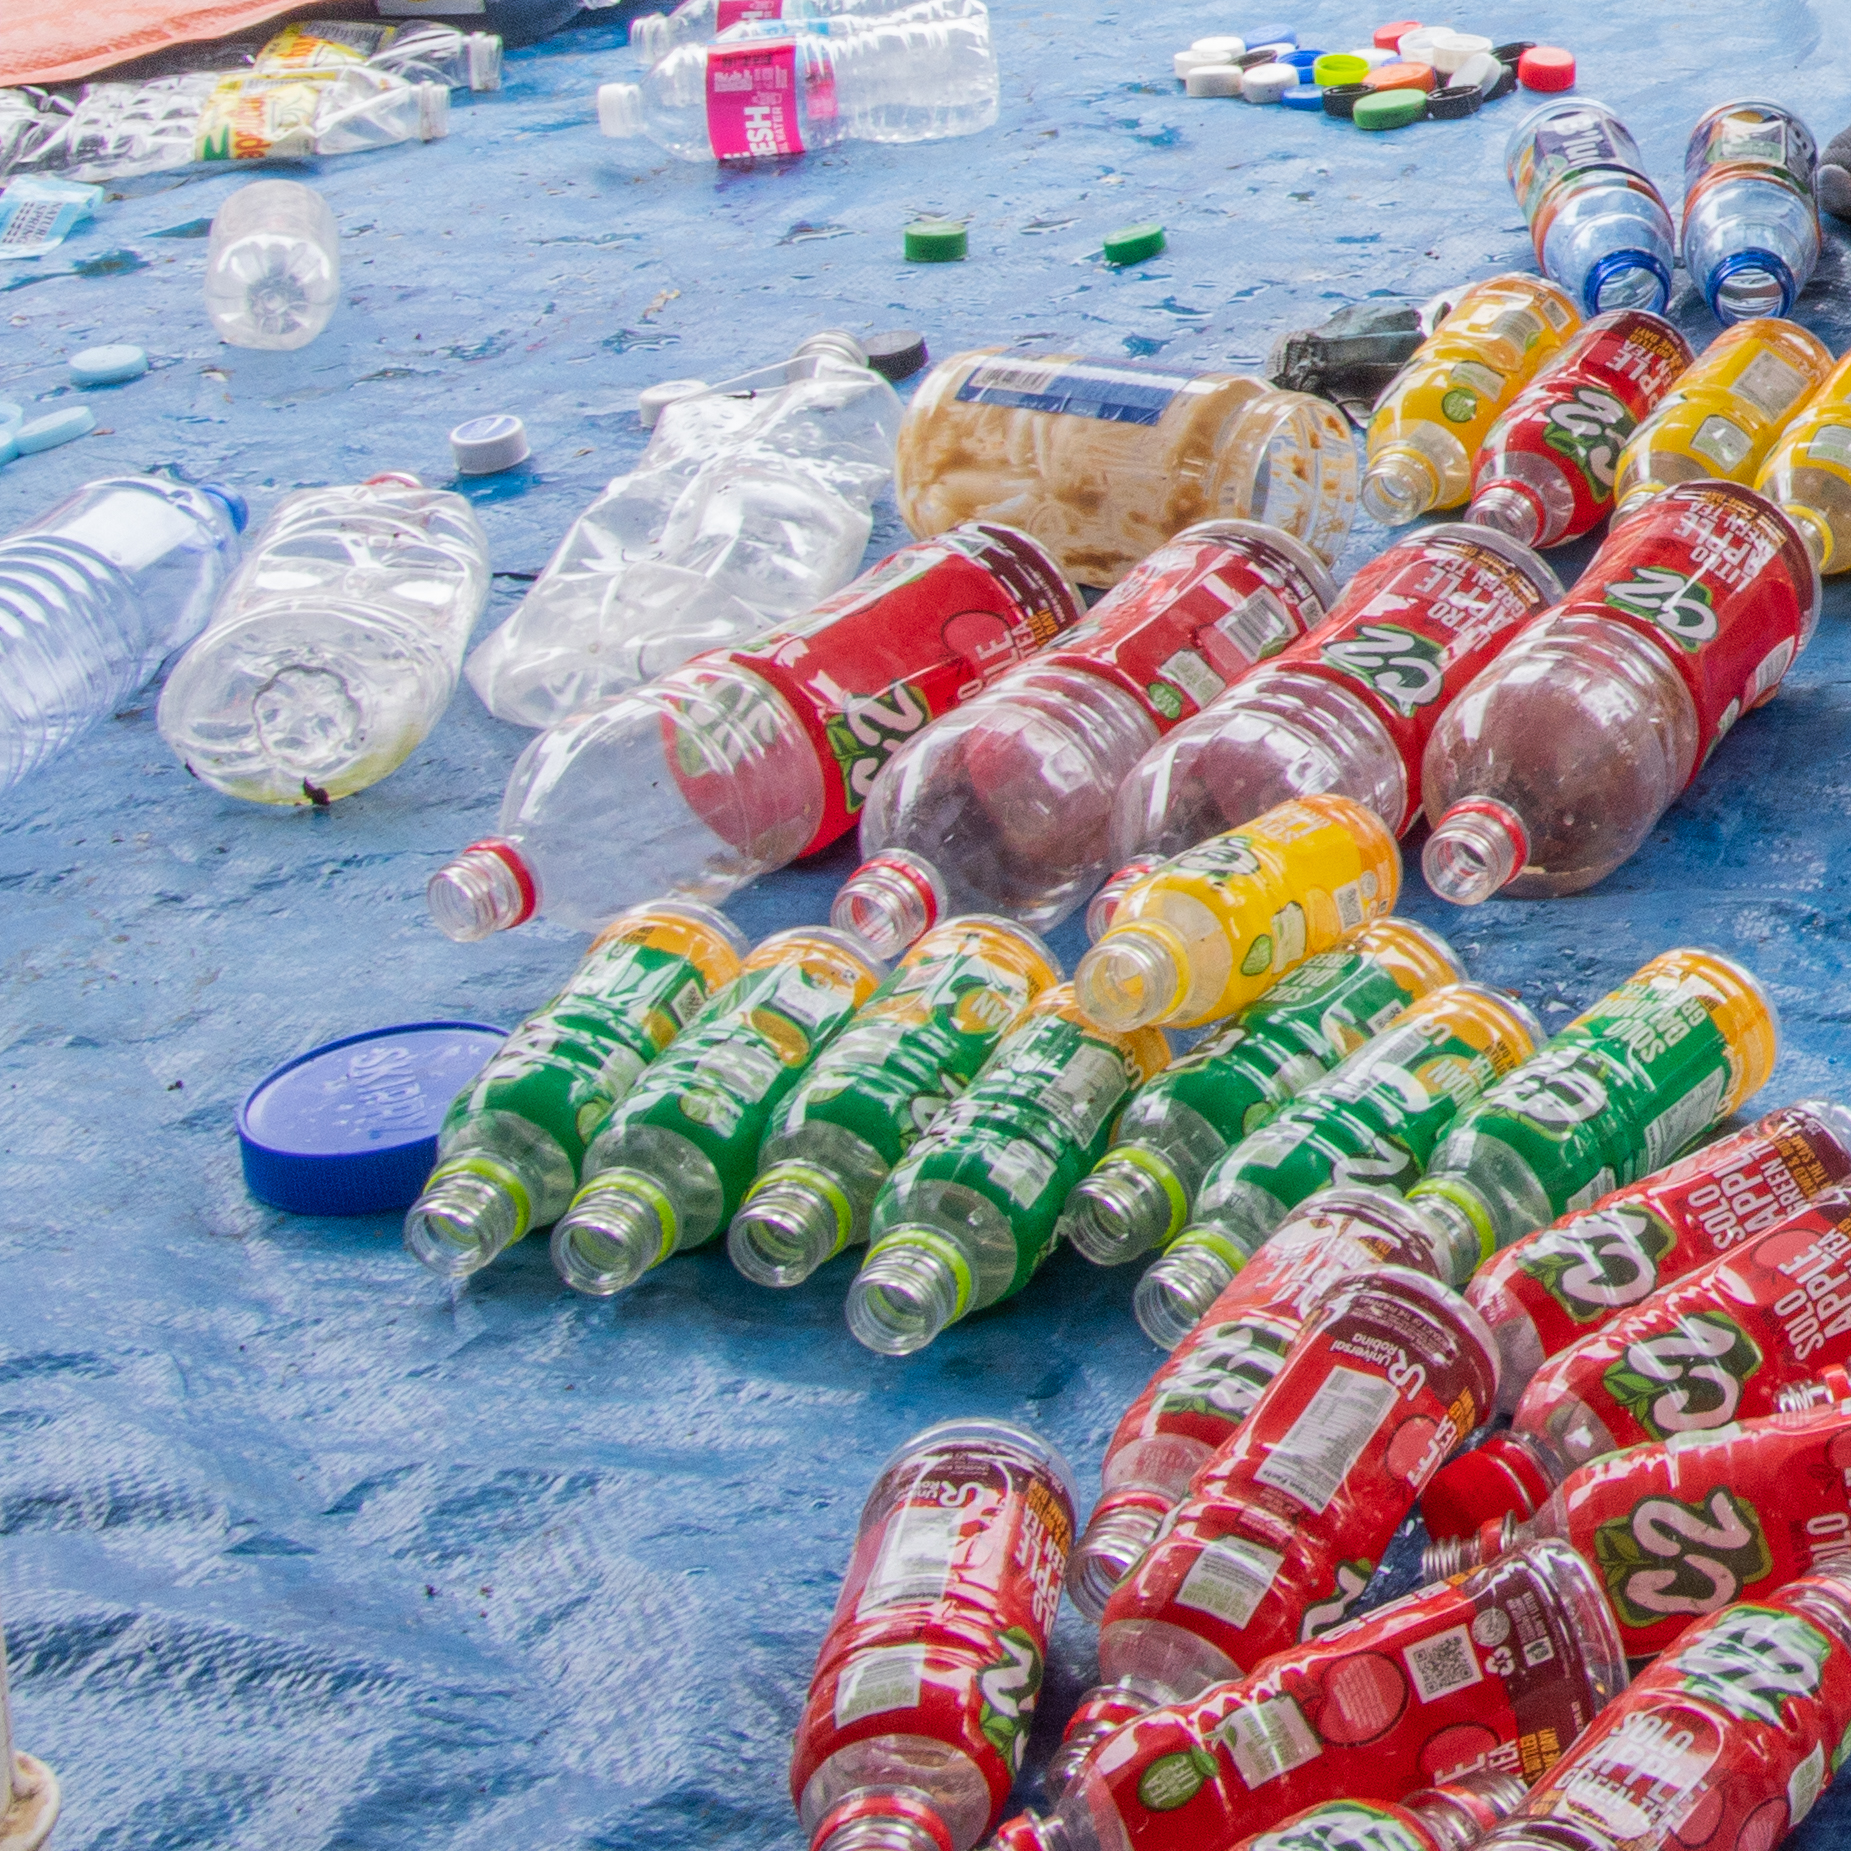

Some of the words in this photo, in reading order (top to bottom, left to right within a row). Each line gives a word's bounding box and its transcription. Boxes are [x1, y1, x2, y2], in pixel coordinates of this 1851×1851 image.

[1673, 515, 1774, 575] APPLE
[1688, 545, 1753, 594] LITRO
[1604, 565, 1718, 642] C2
[1323, 624, 1443, 705] C2
[1688, 1185, 1735, 1250] SOLO
[1759, 1155, 1807, 1219] GREEN
[1329, 1339, 1392, 1367] Universal
[1351, 1332, 1401, 1358] Robina
[1773, 1288, 1824, 1362] SOLO
[1387, 1349, 1427, 1401] UR
[1628, 1316, 1746, 1432] C2
[1625, 1486, 1753, 1614] C2
[1611, 1709, 1695, 1760] SOLO
[1555, 1771, 1632, 1816] GREEN
[1582, 1736, 1708, 1811] APPLE
